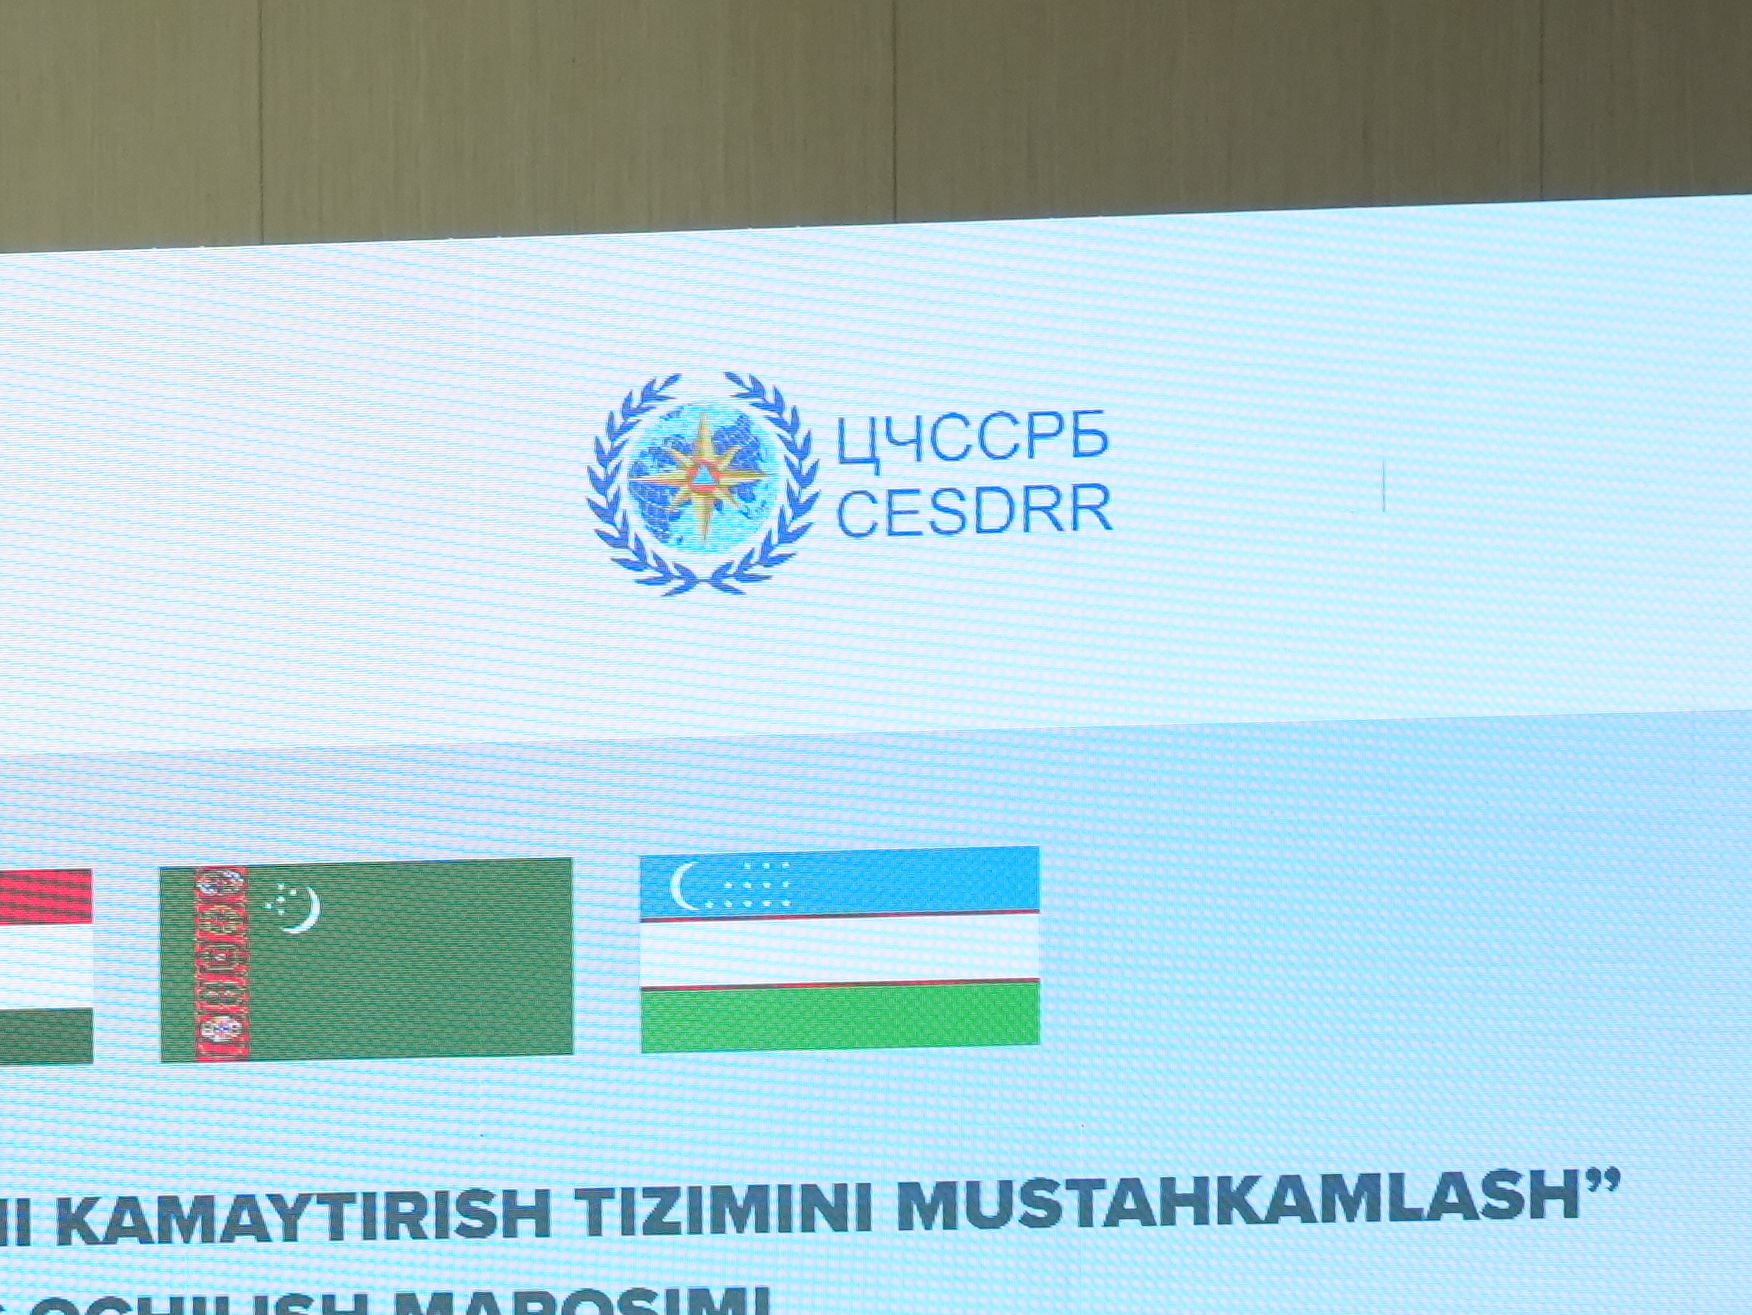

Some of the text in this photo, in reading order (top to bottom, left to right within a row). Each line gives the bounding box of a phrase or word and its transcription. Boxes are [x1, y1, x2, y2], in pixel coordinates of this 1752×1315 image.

[838, 409, 1109, 476] ЦЧССРБ
[836, 483, 1113, 538] CESDRR
[55, 1188, 552, 1247] KAMAYTIRISH
[572, 1182, 873, 1238] TIZIMINI
